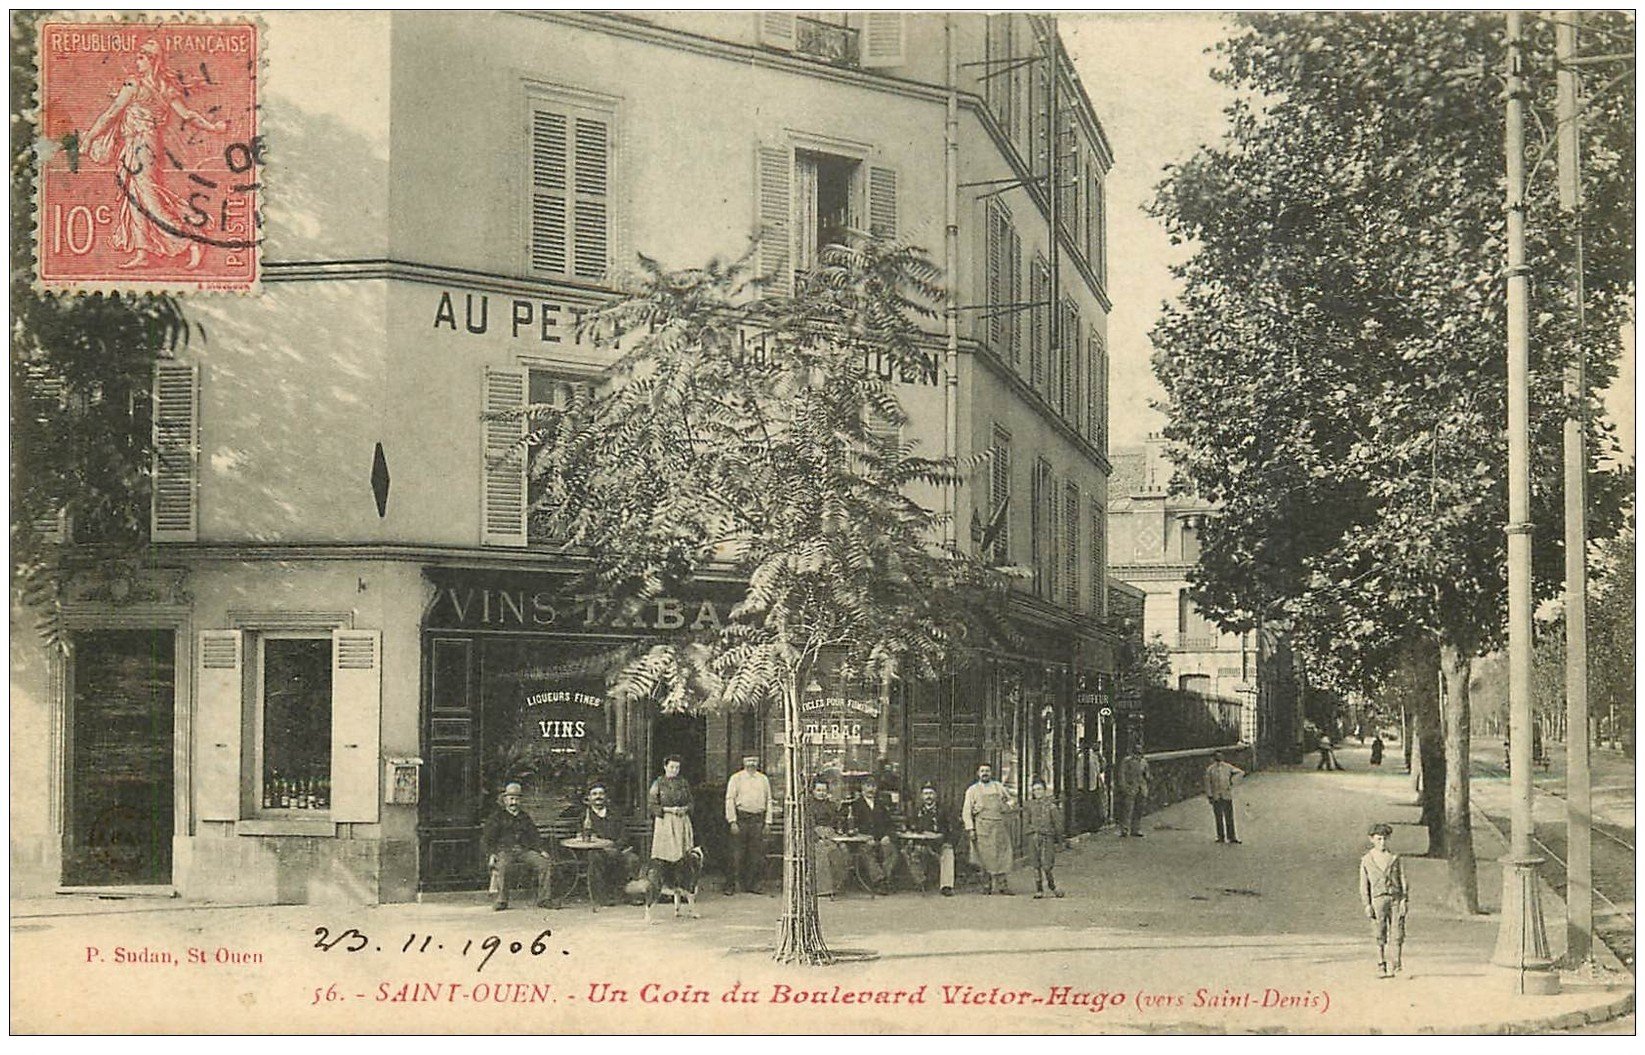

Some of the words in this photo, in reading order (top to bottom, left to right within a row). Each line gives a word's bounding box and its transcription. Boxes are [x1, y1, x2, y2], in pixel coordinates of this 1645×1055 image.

[433, 291, 489, 335] AU
[449, 588, 556, 625] VINS
[574, 593, 724, 630] TABA
[526, 691, 571, 707] LIQUEURS
[574, 692, 602, 707] FINES
[539, 721, 586, 738] VINS
[805, 724, 861, 740] TABAC
